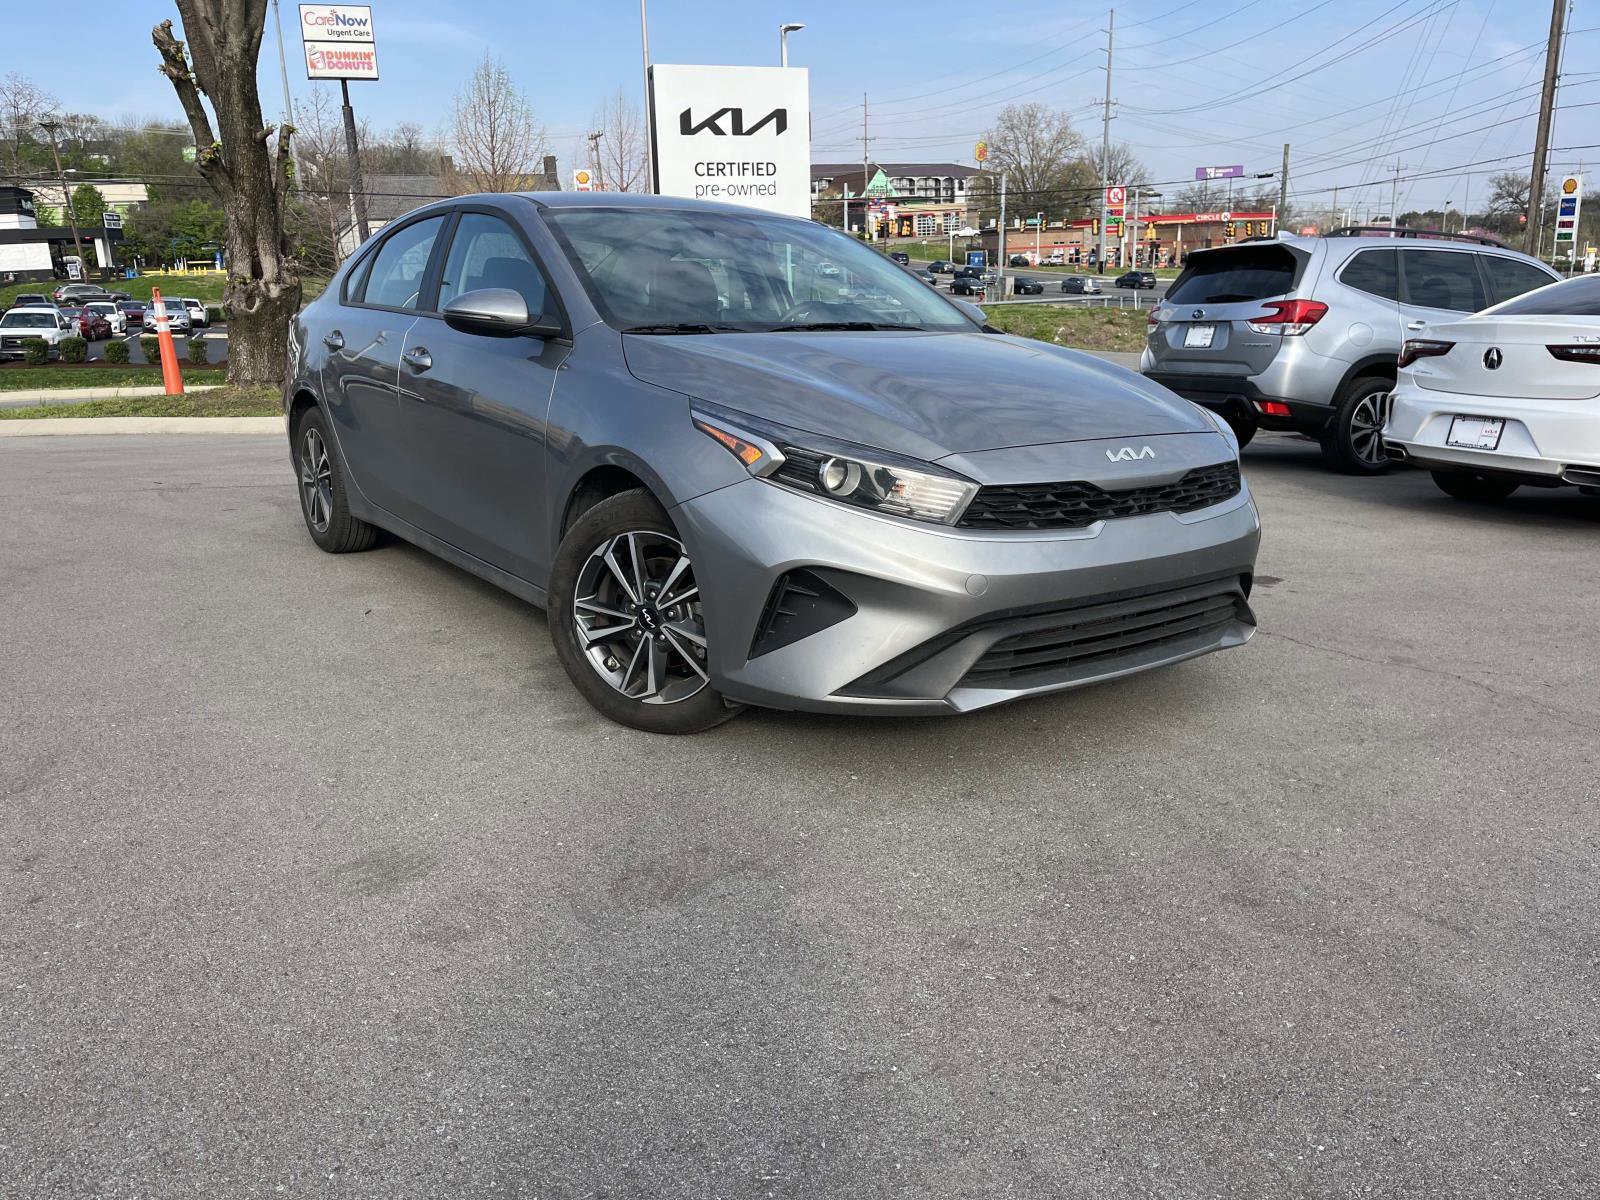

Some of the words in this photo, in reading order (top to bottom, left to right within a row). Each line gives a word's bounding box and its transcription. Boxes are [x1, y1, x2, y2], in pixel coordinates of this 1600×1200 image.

[304, 11, 368, 26] CareNow
[327, 29, 352, 37] Urgent
[326, 51, 374, 60] DUNKIN'
[327, 61, 373, 70] DONUTS
[680, 107, 787, 136] KIA
[694, 162, 777, 177] CERTIFIED
[695, 180, 777, 199] pre-owned
[1195, 213, 1220, 221] CIRCLE
[1105, 446, 1155, 463] KIA
